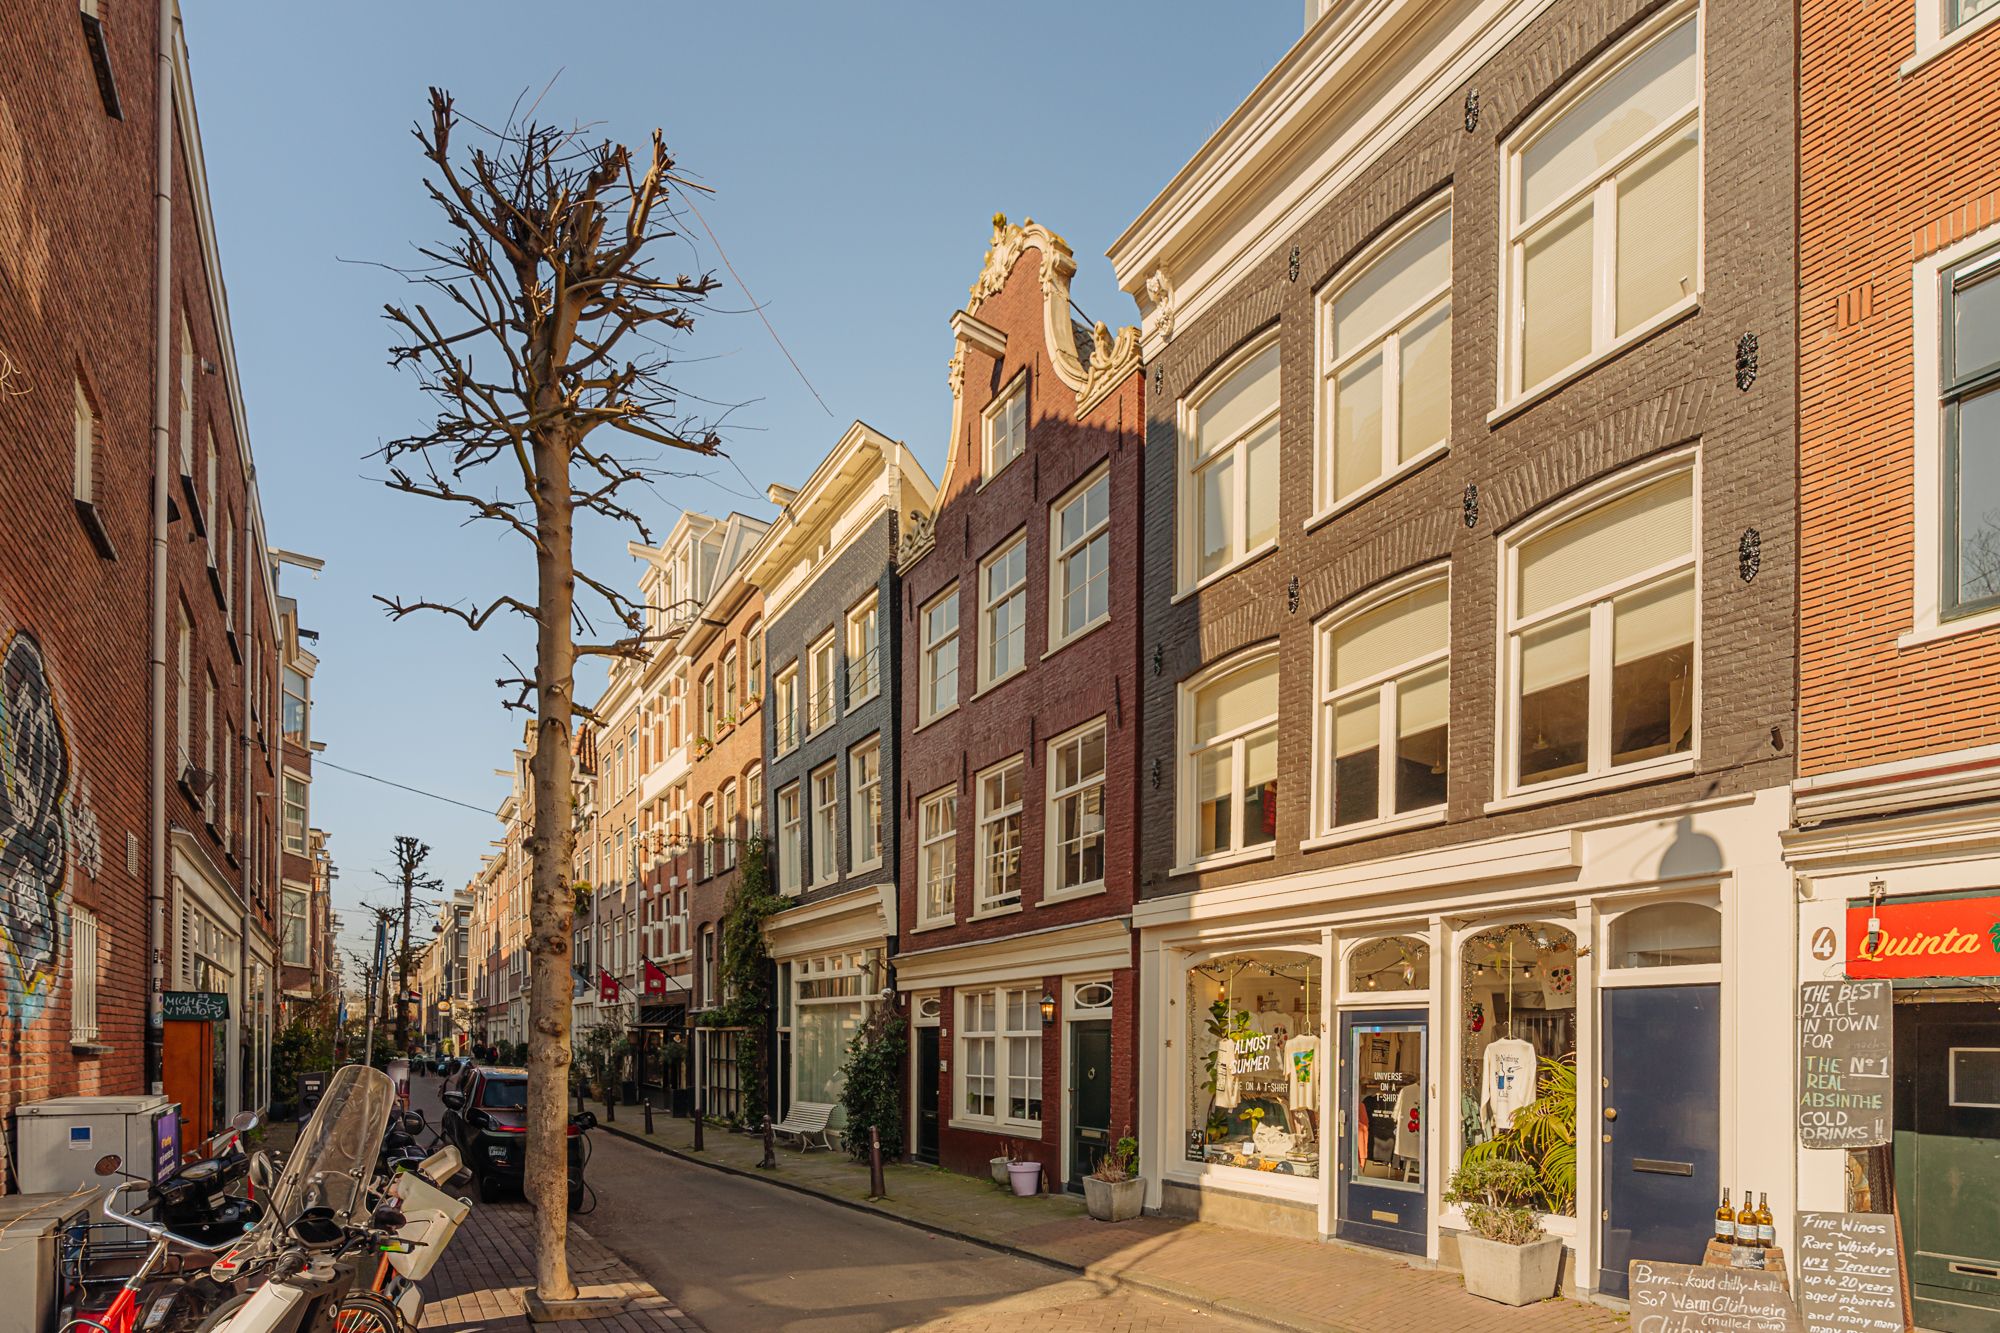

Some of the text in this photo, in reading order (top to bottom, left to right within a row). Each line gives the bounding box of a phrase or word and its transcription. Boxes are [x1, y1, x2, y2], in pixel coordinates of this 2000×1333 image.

[1813, 928, 1833, 957] 4
[1857, 926, 1981, 962] Quinta
[1802, 982, 1883, 1003] THE BEST
[1802, 1000, 1859, 1019] PLACE
[1803, 1014, 1880, 1034] IN TOWN
[1234, 1035, 1273, 1055] ALMOST
[1802, 1034, 1834, 1050] FOR
[1231, 1055, 1271, 1075] SUMMER
[1805, 1056, 1843, 1074] THE
[1880, 1056, 1889, 1076] 1
[1373, 1071, 1403, 1081] UNIVERSE
[1806, 1073, 1847, 1091] REAL
[1245, 1081, 1254, 1091] ON
[1256, 1081, 1261, 1092] A
[1263, 1082, 1289, 1093] T-SHIRT
[1380, 1082, 1396, 1091] ON A
[1375, 1092, 1399, 1102] T-SHIR
[1800, 1092, 1883, 1110] ABSINTHE
[1800, 1111, 1848, 1127] COLD
[1803, 1126, 1869, 1140] DRINKS
[1801, 1213, 1887, 1234] Fine Wines
[1801, 1235, 1896, 1258] Rare Whiskys
[1834, 1259, 1897, 1275] Jenever
[1685, 1269, 1716, 1290] koud
[1804, 1274, 1895, 1294] up to 20 years
[1637, 1290, 1786, 1318] So? Warm Glühwein
[1805, 1291, 1896, 1309] aged in barrels
[1701, 1315, 1786, 1331] (mulled wine)
[1807, 1312, 1902, 1333] and many many
